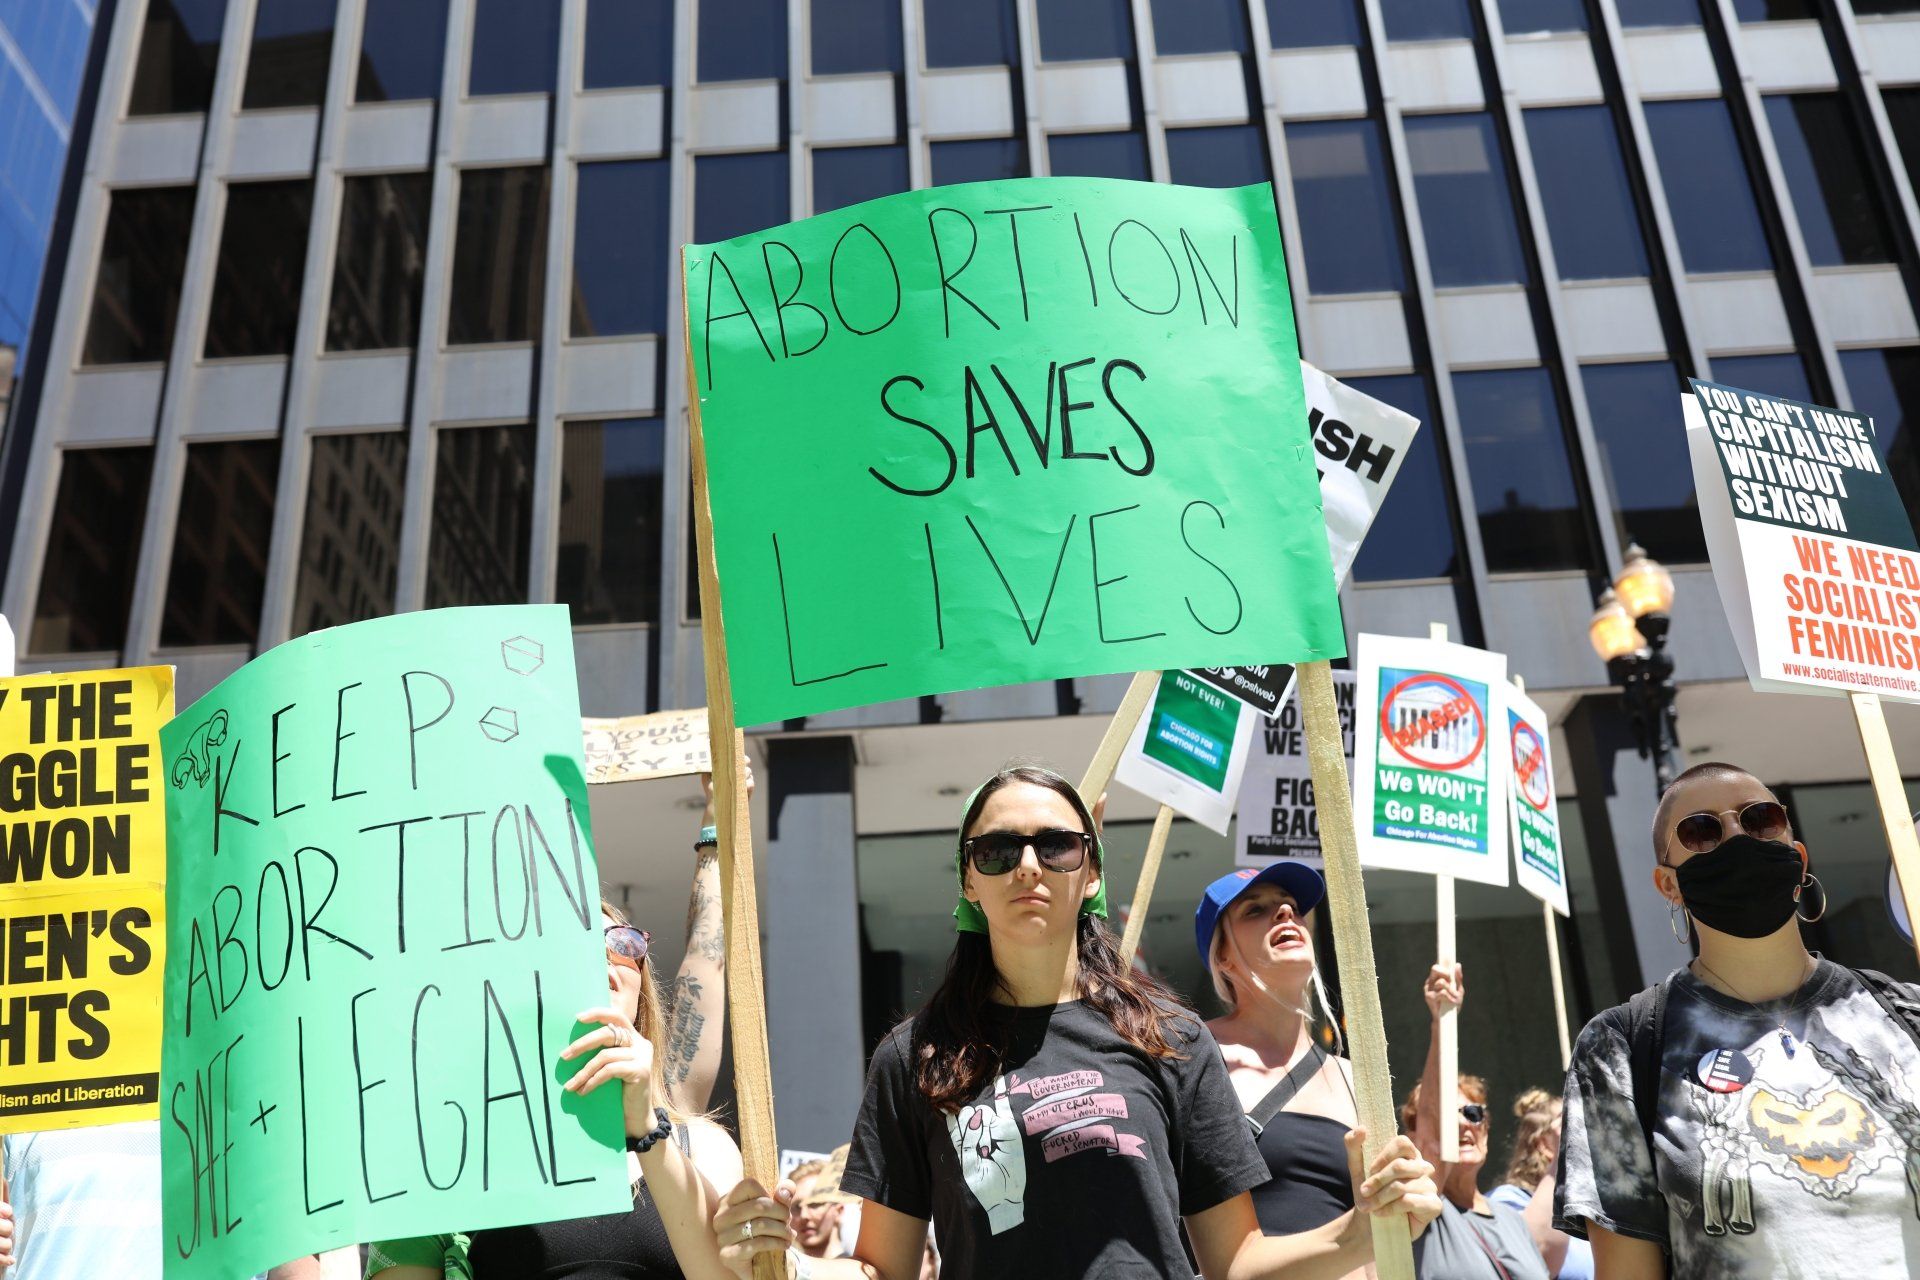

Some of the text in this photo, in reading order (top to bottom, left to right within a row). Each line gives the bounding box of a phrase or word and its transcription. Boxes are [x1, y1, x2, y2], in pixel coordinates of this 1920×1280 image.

[706, 205, 1239, 391] ABORTION
[868, 357, 1155, 497] SAVES
[1696, 384, 1865, 441] YOU CAN'T HAVE
[1708, 410, 1882, 474] CAPITALISM
[1719, 442, 1848, 498] WITHOUT
[1731, 478, 1848, 532] SEXISM
[1792, 535, 1920, 590] WE NEED
[772, 500, 1242, 686] LIVES
[1175, 675, 1225, 711] NOT EVER!
[1234, 674, 1276, 703] @pslweb
[1782, 662, 1920, 692] www.socialistalternative.
[21, 679, 132, 744] THE
[1169, 721, 1214, 750] CHICAGO FOR
[1395, 697, 1471, 747] BIASED
[212, 670, 456, 855] KEEP
[1159, 730, 1218, 765] ABORTION RIGHTS
[1264, 731, 1302, 756] WE
[1275, 777, 1316, 807] FIG
[1379, 769, 1486, 806] We WON'T
[1384, 799, 1478, 834] Go Back!
[0, 814, 130, 884] WON
[185, 797, 592, 1037] ABORTION
[0, 907, 151, 986] EN'S
[32, 1088, 61, 1105] and
[64, 1083, 144, 1102] Liberation
[171, 970, 596, 1260] SAFE + LEGAL
